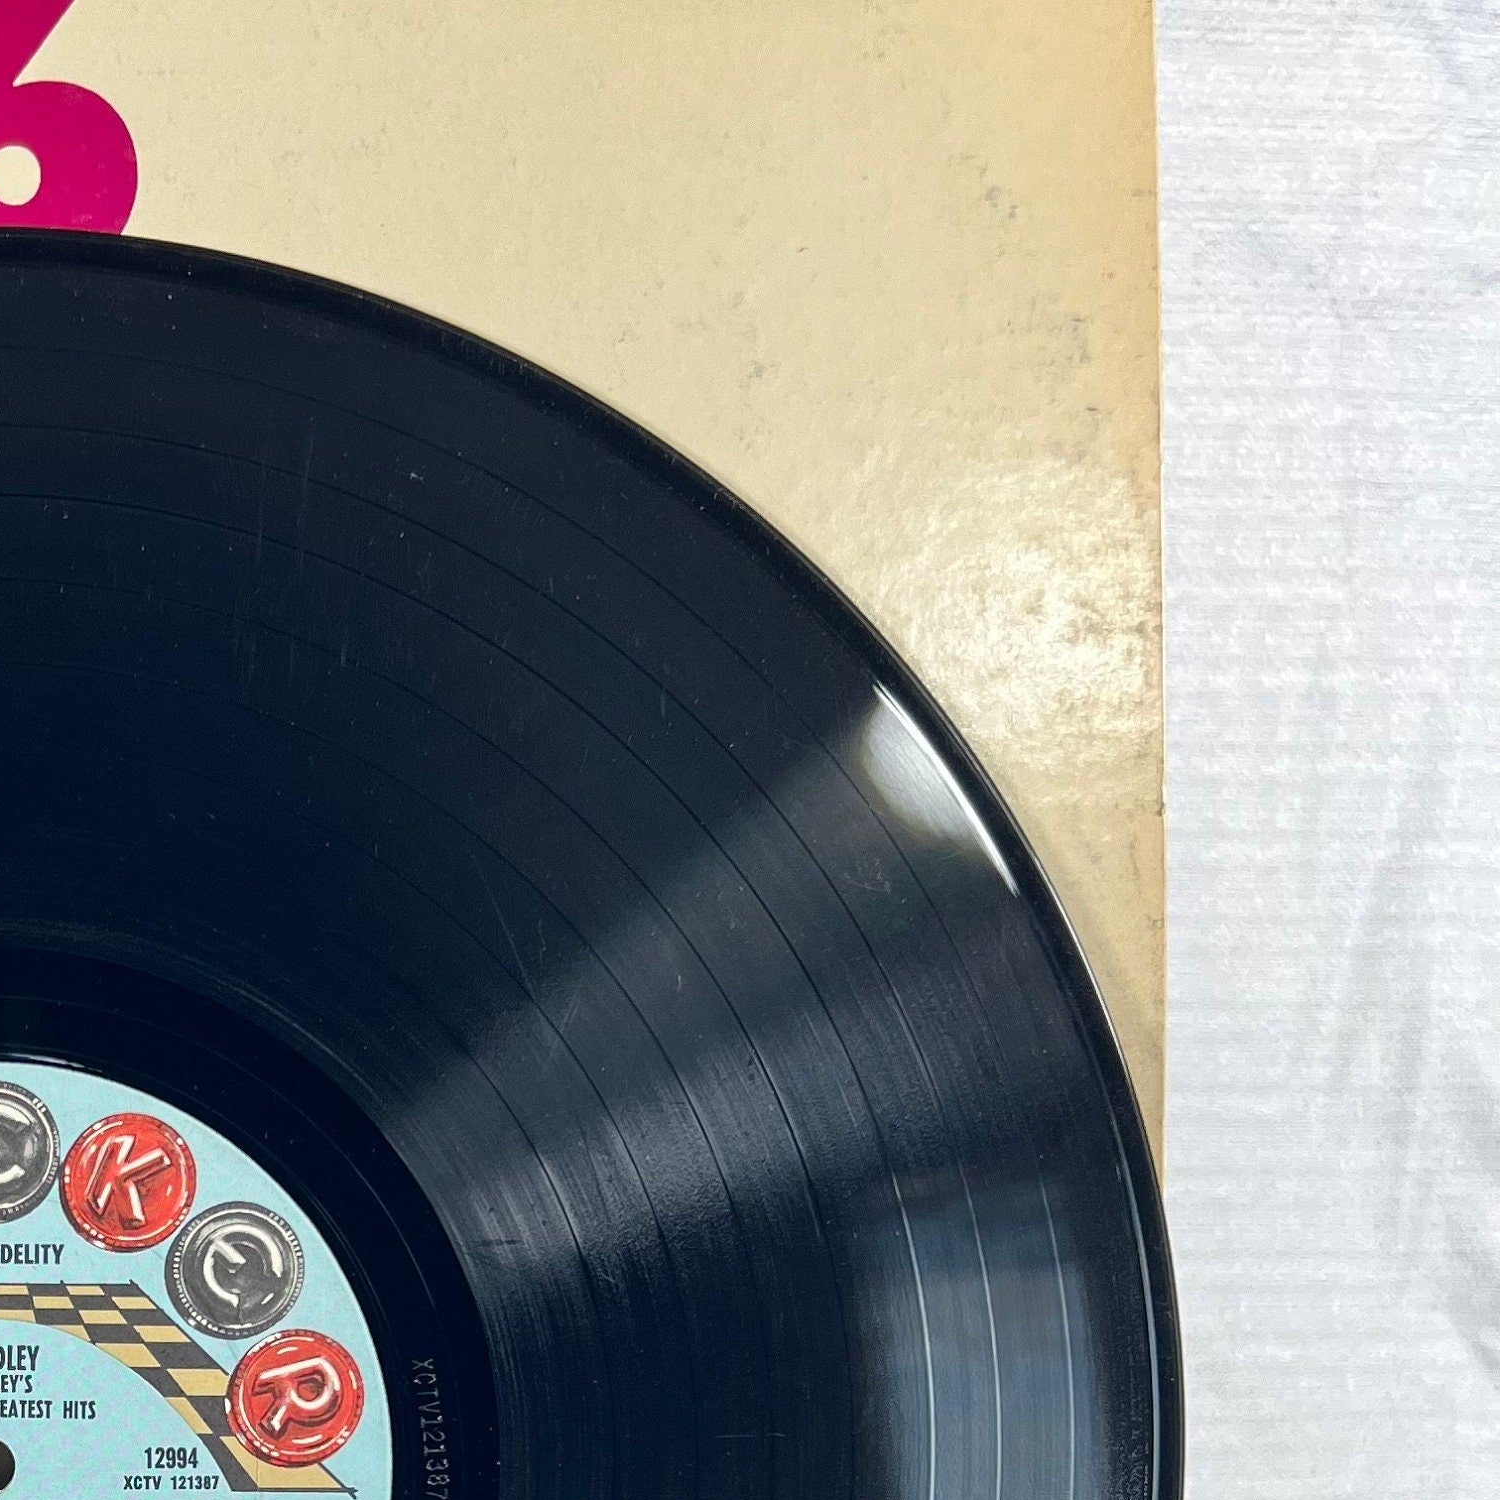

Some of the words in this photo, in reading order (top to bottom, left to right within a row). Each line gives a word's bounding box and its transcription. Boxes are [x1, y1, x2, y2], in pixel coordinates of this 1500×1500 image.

[62, 1400, 96, 1420] HITS
[144, 1446, 199, 1469] 12994
[123, 1475, 162, 1491] XCTV
[170, 1475, 220, 1491] 121387
